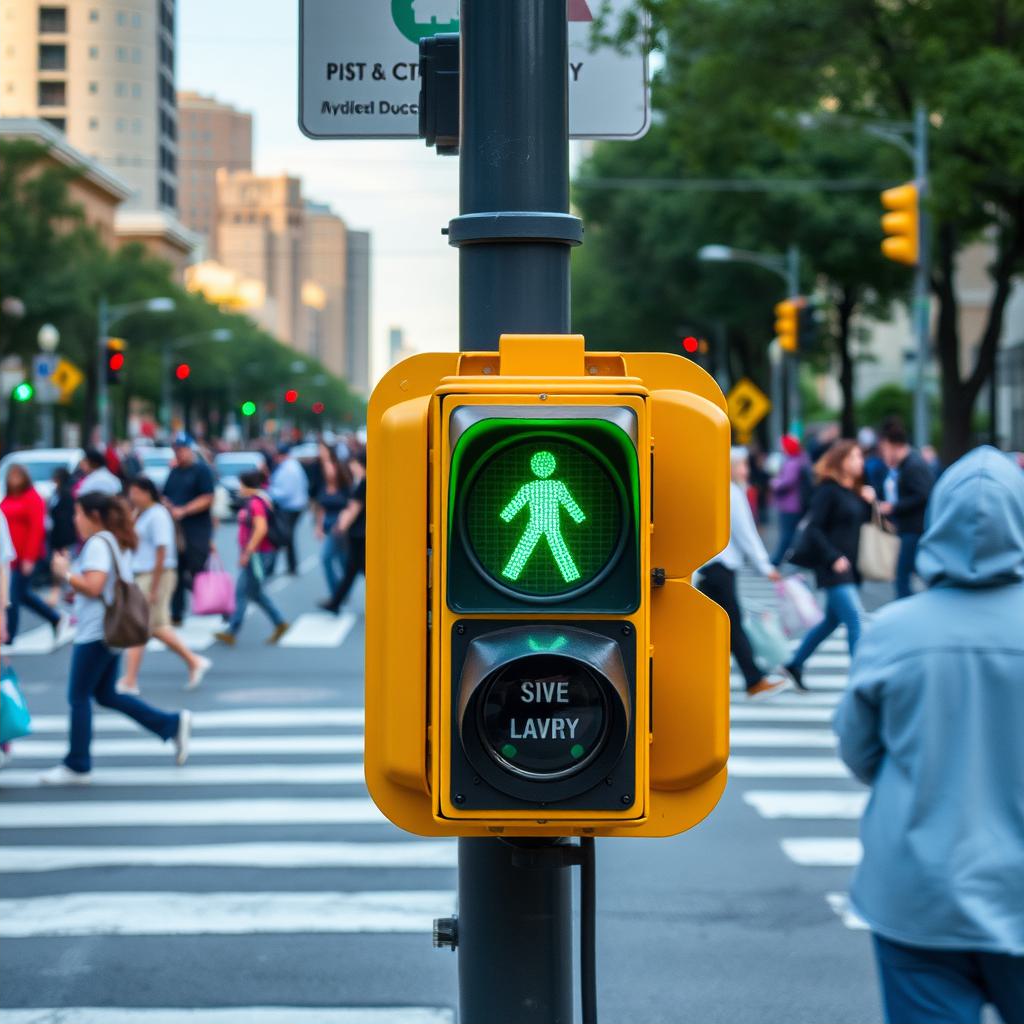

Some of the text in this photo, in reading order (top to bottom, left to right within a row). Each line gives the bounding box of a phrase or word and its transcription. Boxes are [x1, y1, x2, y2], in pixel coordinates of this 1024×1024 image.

[327, 62, 367, 81] PIST
[372, 62, 387, 81] &
[520, 681, 569, 703] SIVE
[510, 718, 579, 739] LAVRY
